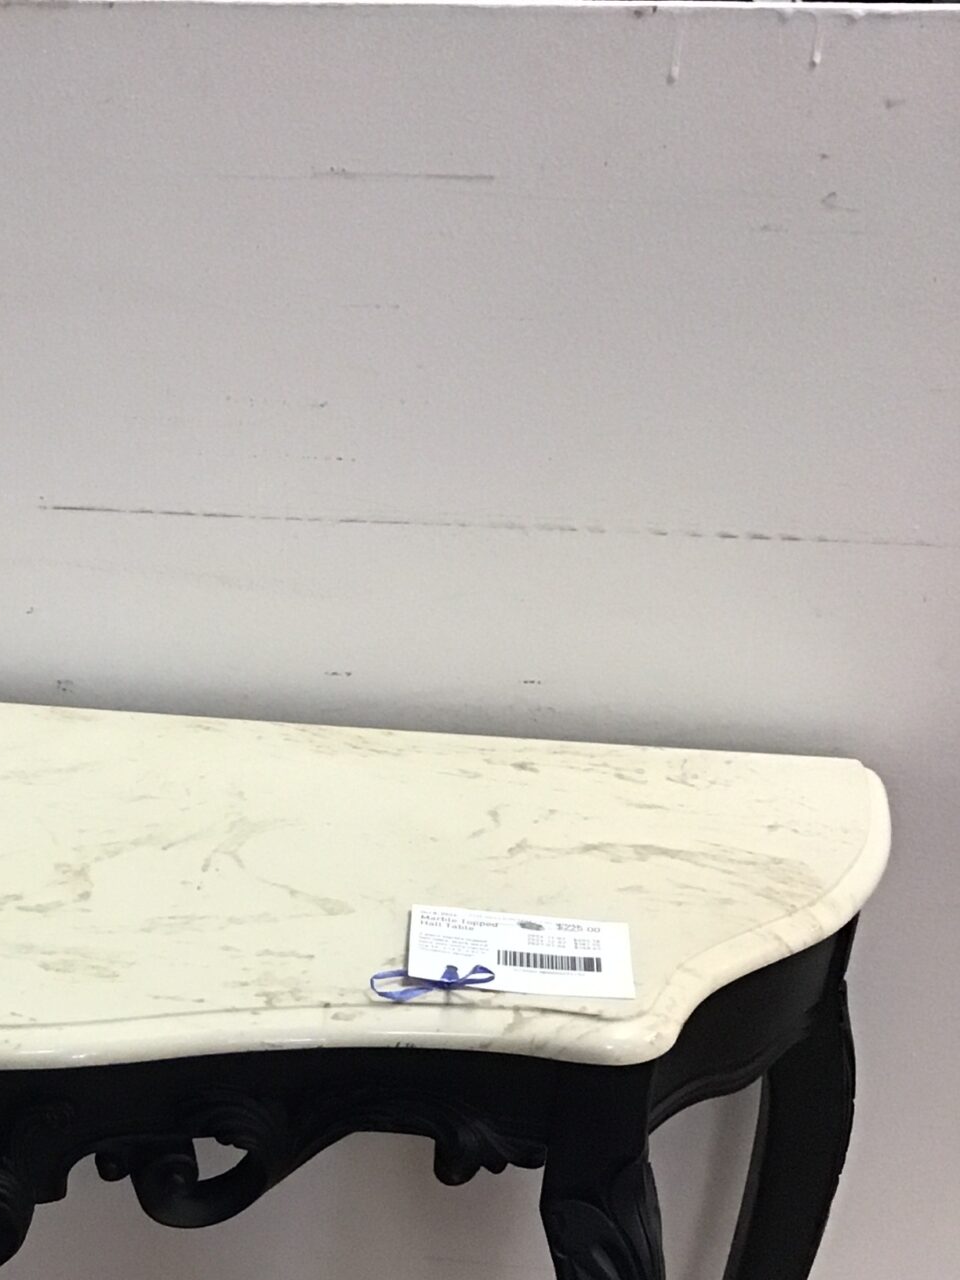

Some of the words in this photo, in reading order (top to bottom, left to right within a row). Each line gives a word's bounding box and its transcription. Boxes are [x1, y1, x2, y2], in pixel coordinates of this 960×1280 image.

[420, 914, 458, 923] Marble
[461, 918, 499, 928] Topped
[446, 922, 474, 931] Table
